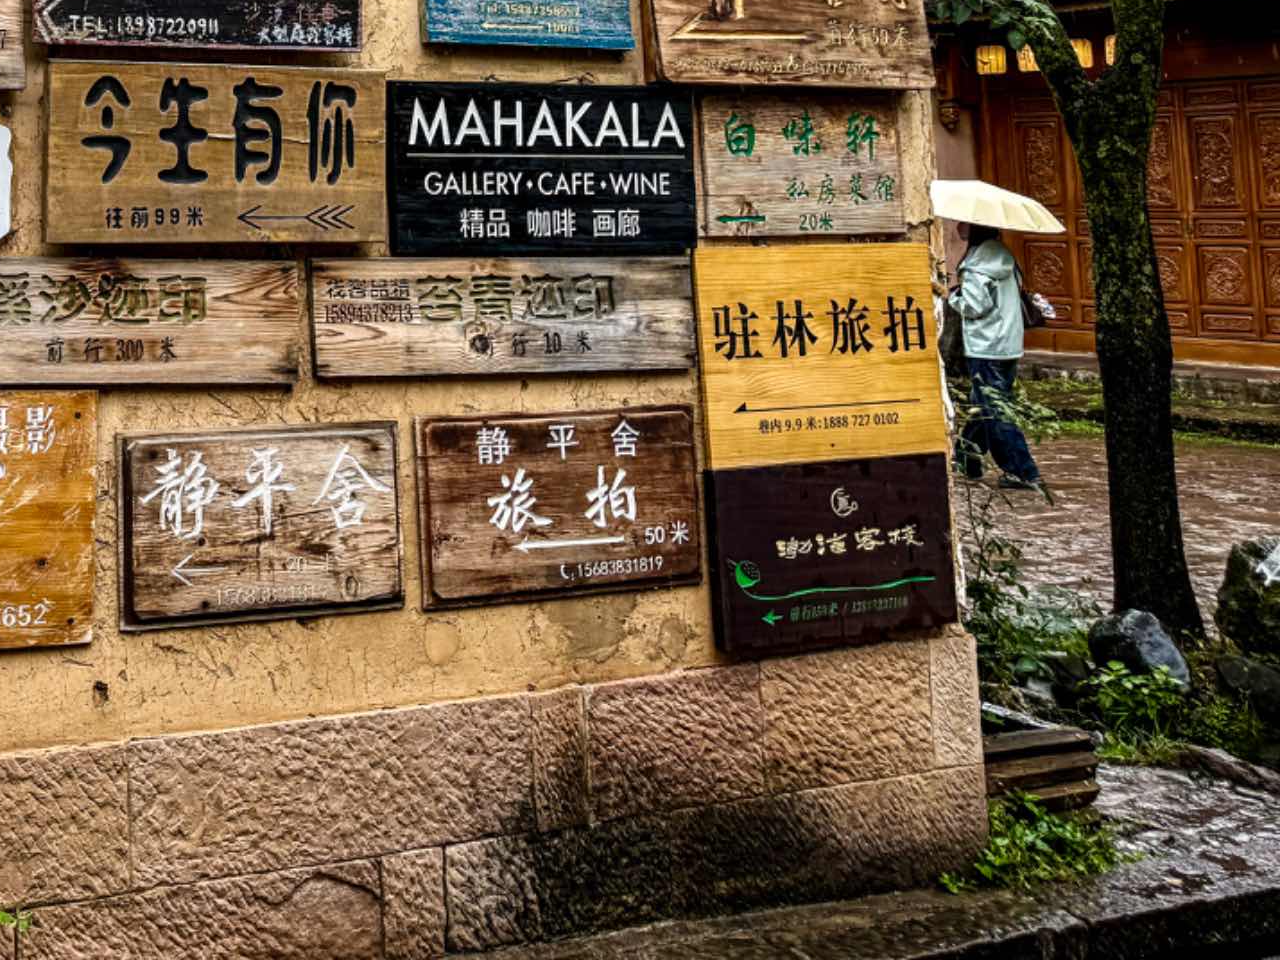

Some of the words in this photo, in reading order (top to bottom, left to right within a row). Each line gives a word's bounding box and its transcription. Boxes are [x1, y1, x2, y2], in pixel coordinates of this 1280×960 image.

[80, 74, 358, 186] 今生有你
[407, 96, 686, 149] MAHAKALA
[423, 171, 523, 196] GALLERY
[536, 171, 596, 196] CAFE
[609, 171, 671, 196] WINE
[784, 172, 896, 205] 私房菜馆
[105, 206, 204, 229] 往前99米
[459, 208, 511, 239] 精品
[526, 208, 577, 239] 咖啡
[591, 208, 642, 238] 画廊
[798, 212, 834, 232] 20米
[711, 295, 927, 361] 驻林旅拍
[475, 419, 641, 465] 静平舍
[486, 464, 639, 533] 旅拍
